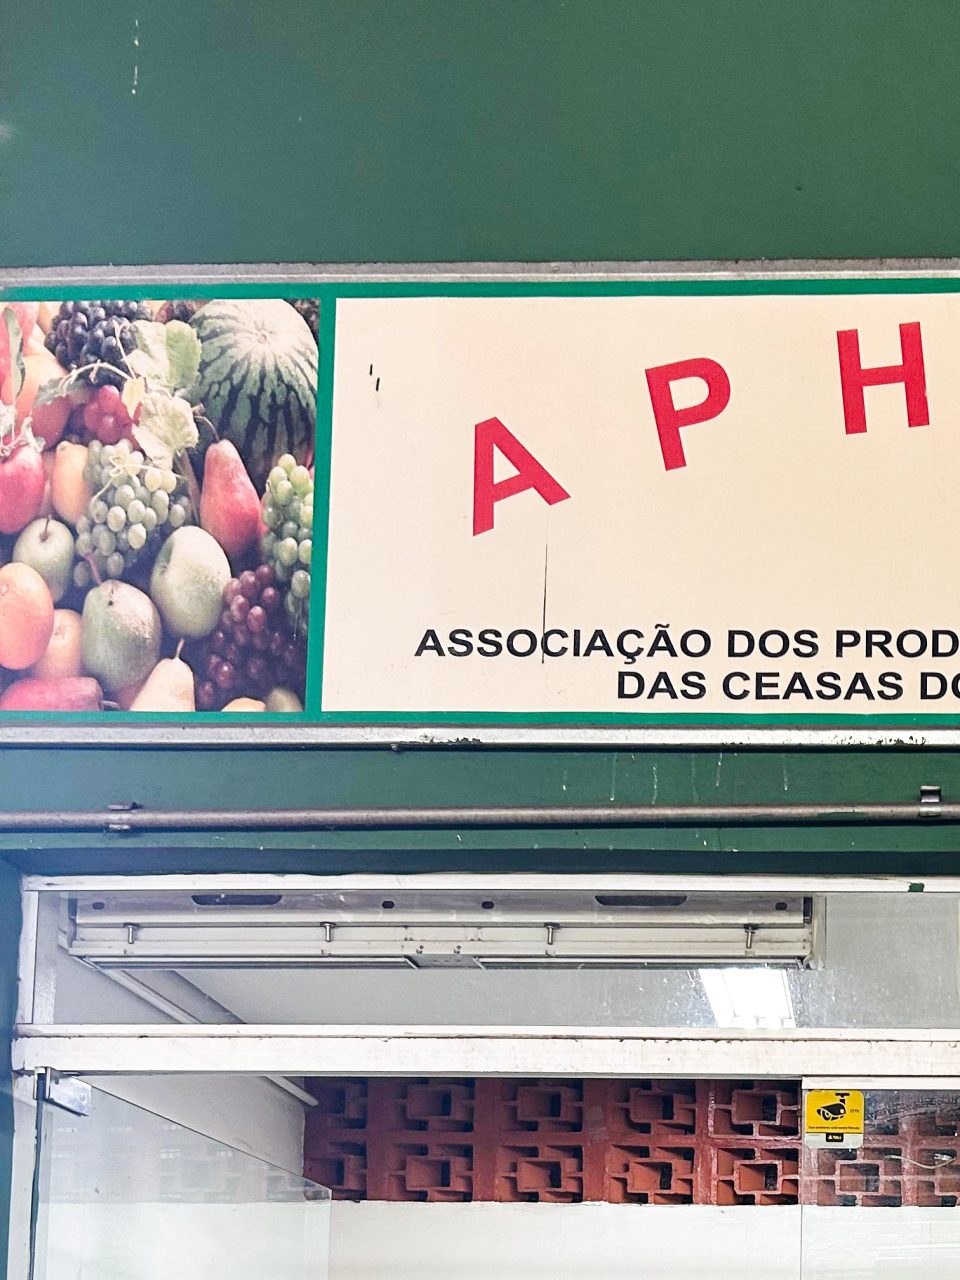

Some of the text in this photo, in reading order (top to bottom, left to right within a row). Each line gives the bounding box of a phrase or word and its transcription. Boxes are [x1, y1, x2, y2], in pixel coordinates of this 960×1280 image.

[414, 624, 712, 664] ASSOCIAÇÃO
[728, 629, 820, 658] DOS
[618, 671, 706, 700] DAS
[722, 671, 903, 701] CEASAS
